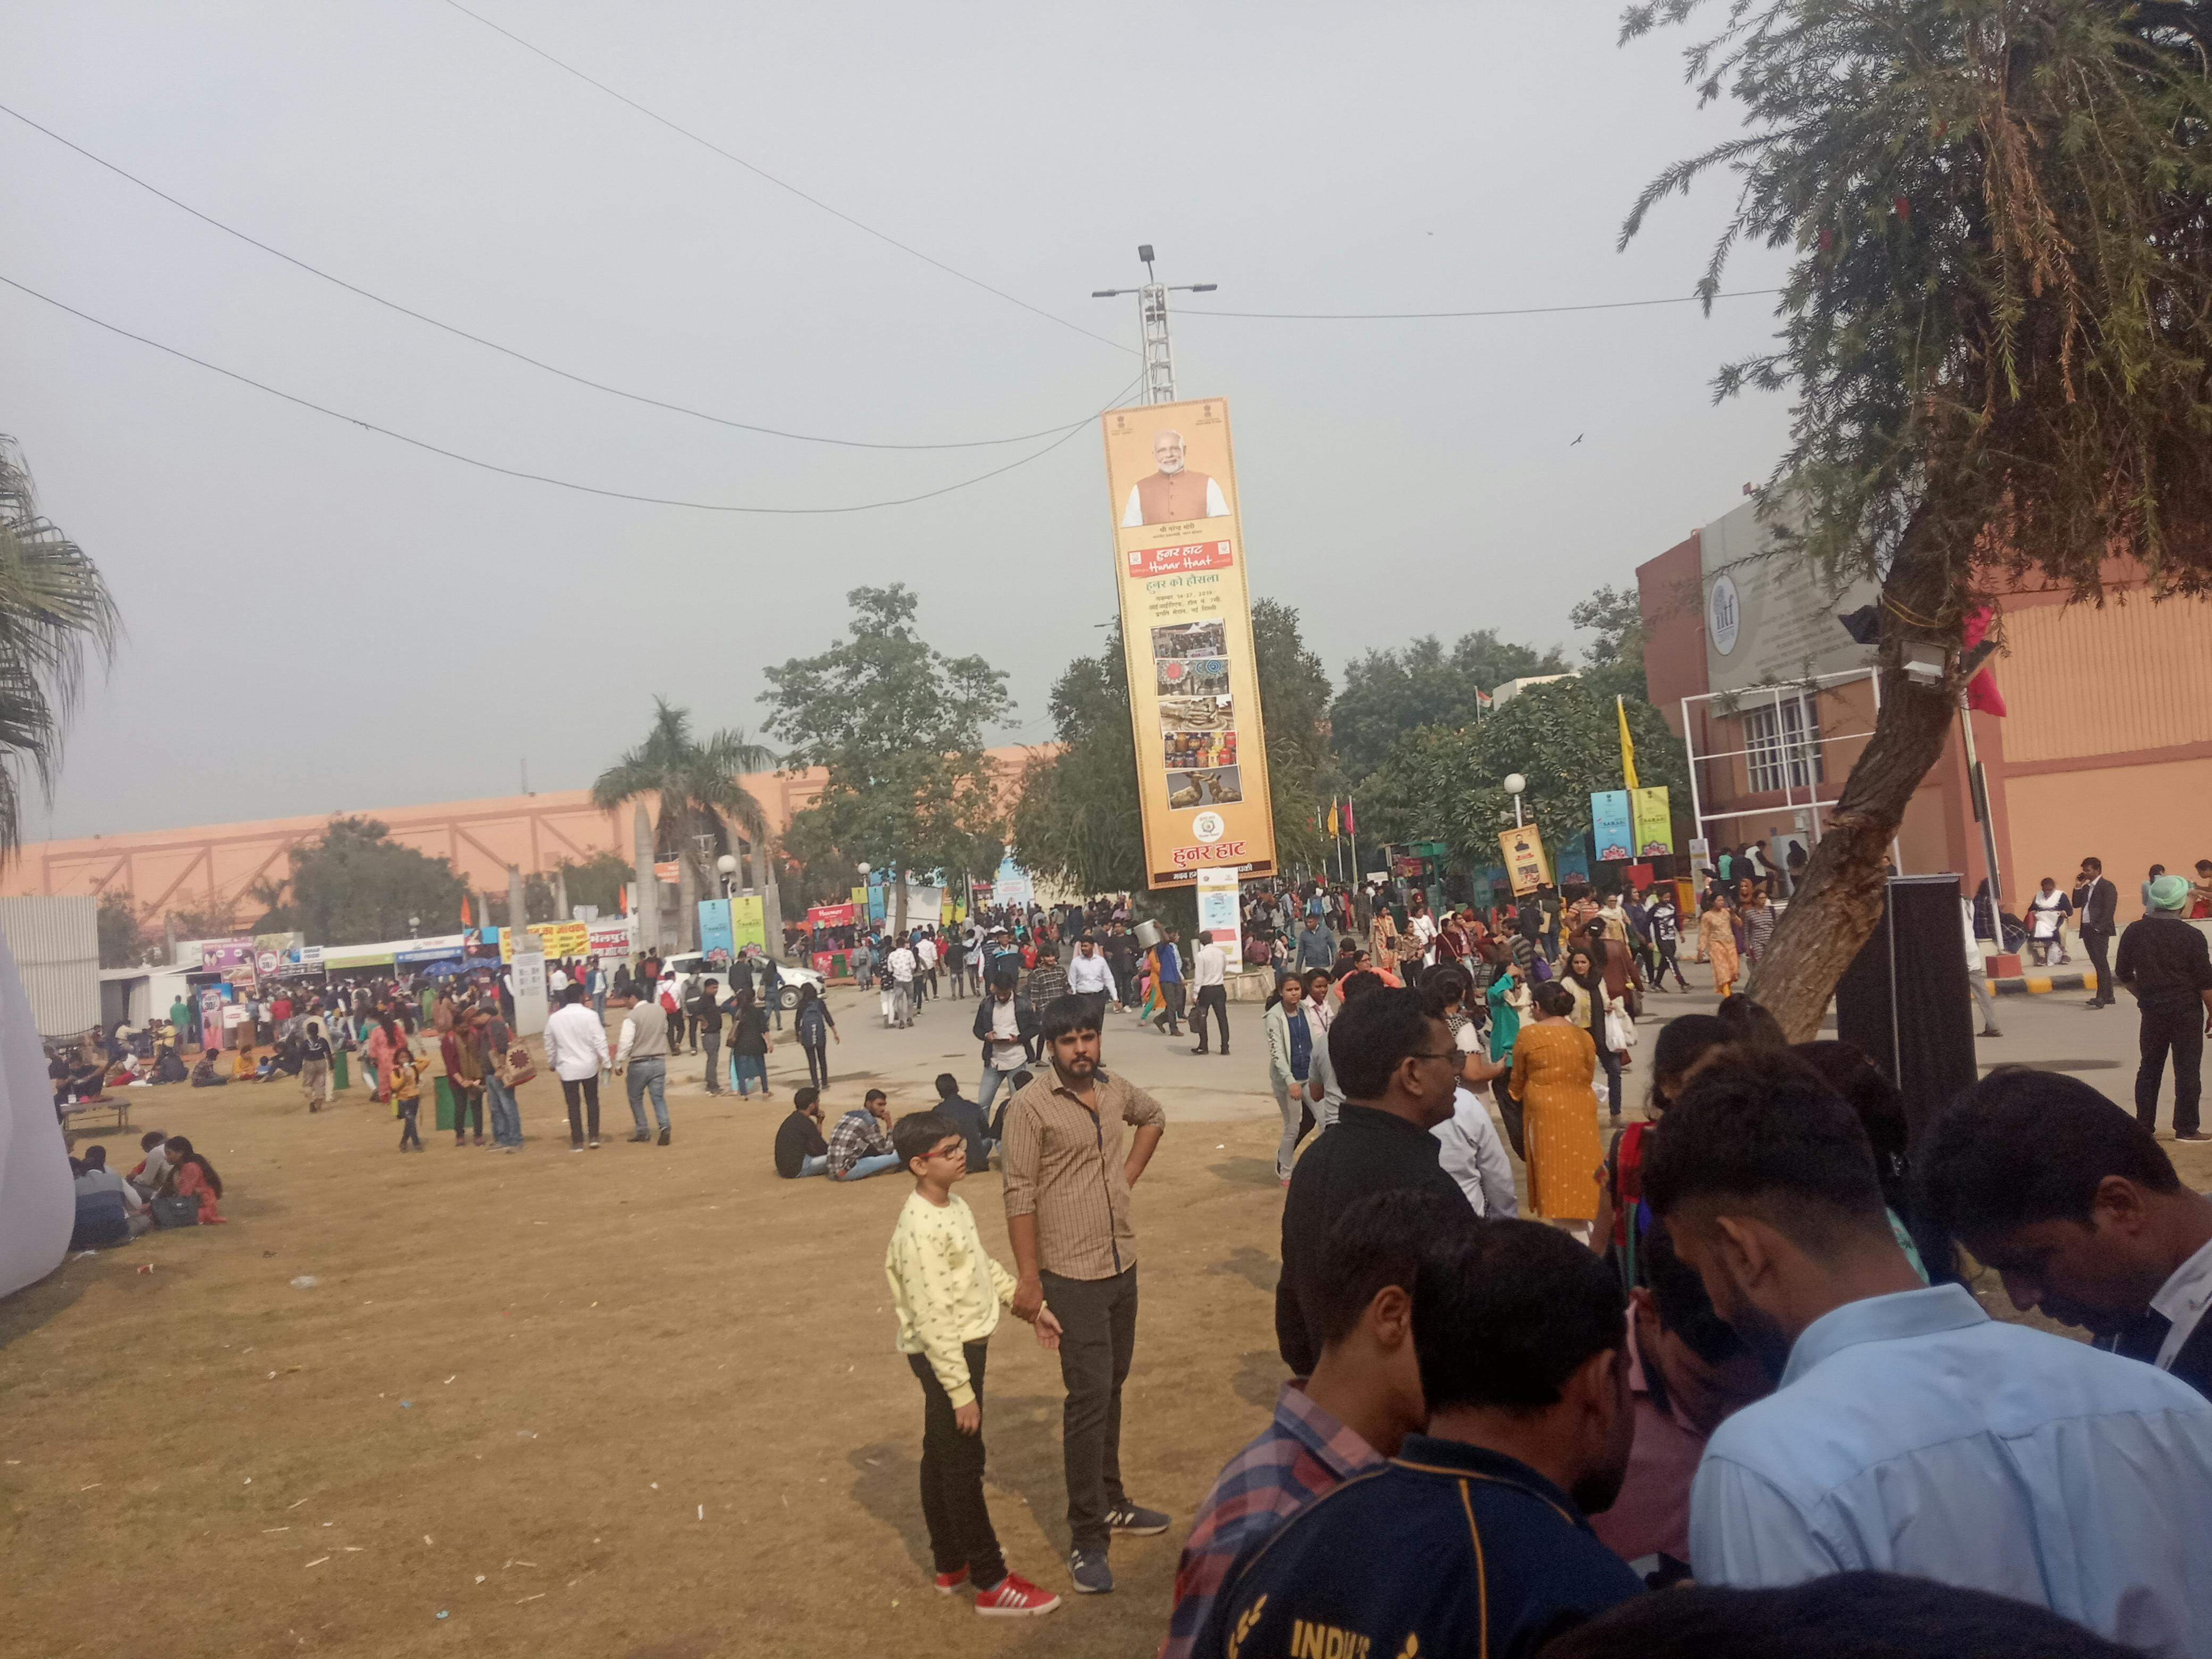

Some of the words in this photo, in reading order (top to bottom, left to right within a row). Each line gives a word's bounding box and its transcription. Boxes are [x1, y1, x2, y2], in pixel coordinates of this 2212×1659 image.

[1156, 548, 1180, 562] हुनर
[1183, 545, 1203, 555] हाट
[1149, 562, 1180, 573] Hunar
[1183, 555, 1212, 569] Haat
[1146, 580, 1166, 594] हुनर
[1170, 576, 1183, 587] को
[1186, 573, 1220, 586] हौसला
[1173, 844, 1212, 868] हुनर
[1216, 840, 1246, 859] हाट
[204, 1002, 218, 1010] 30/-
